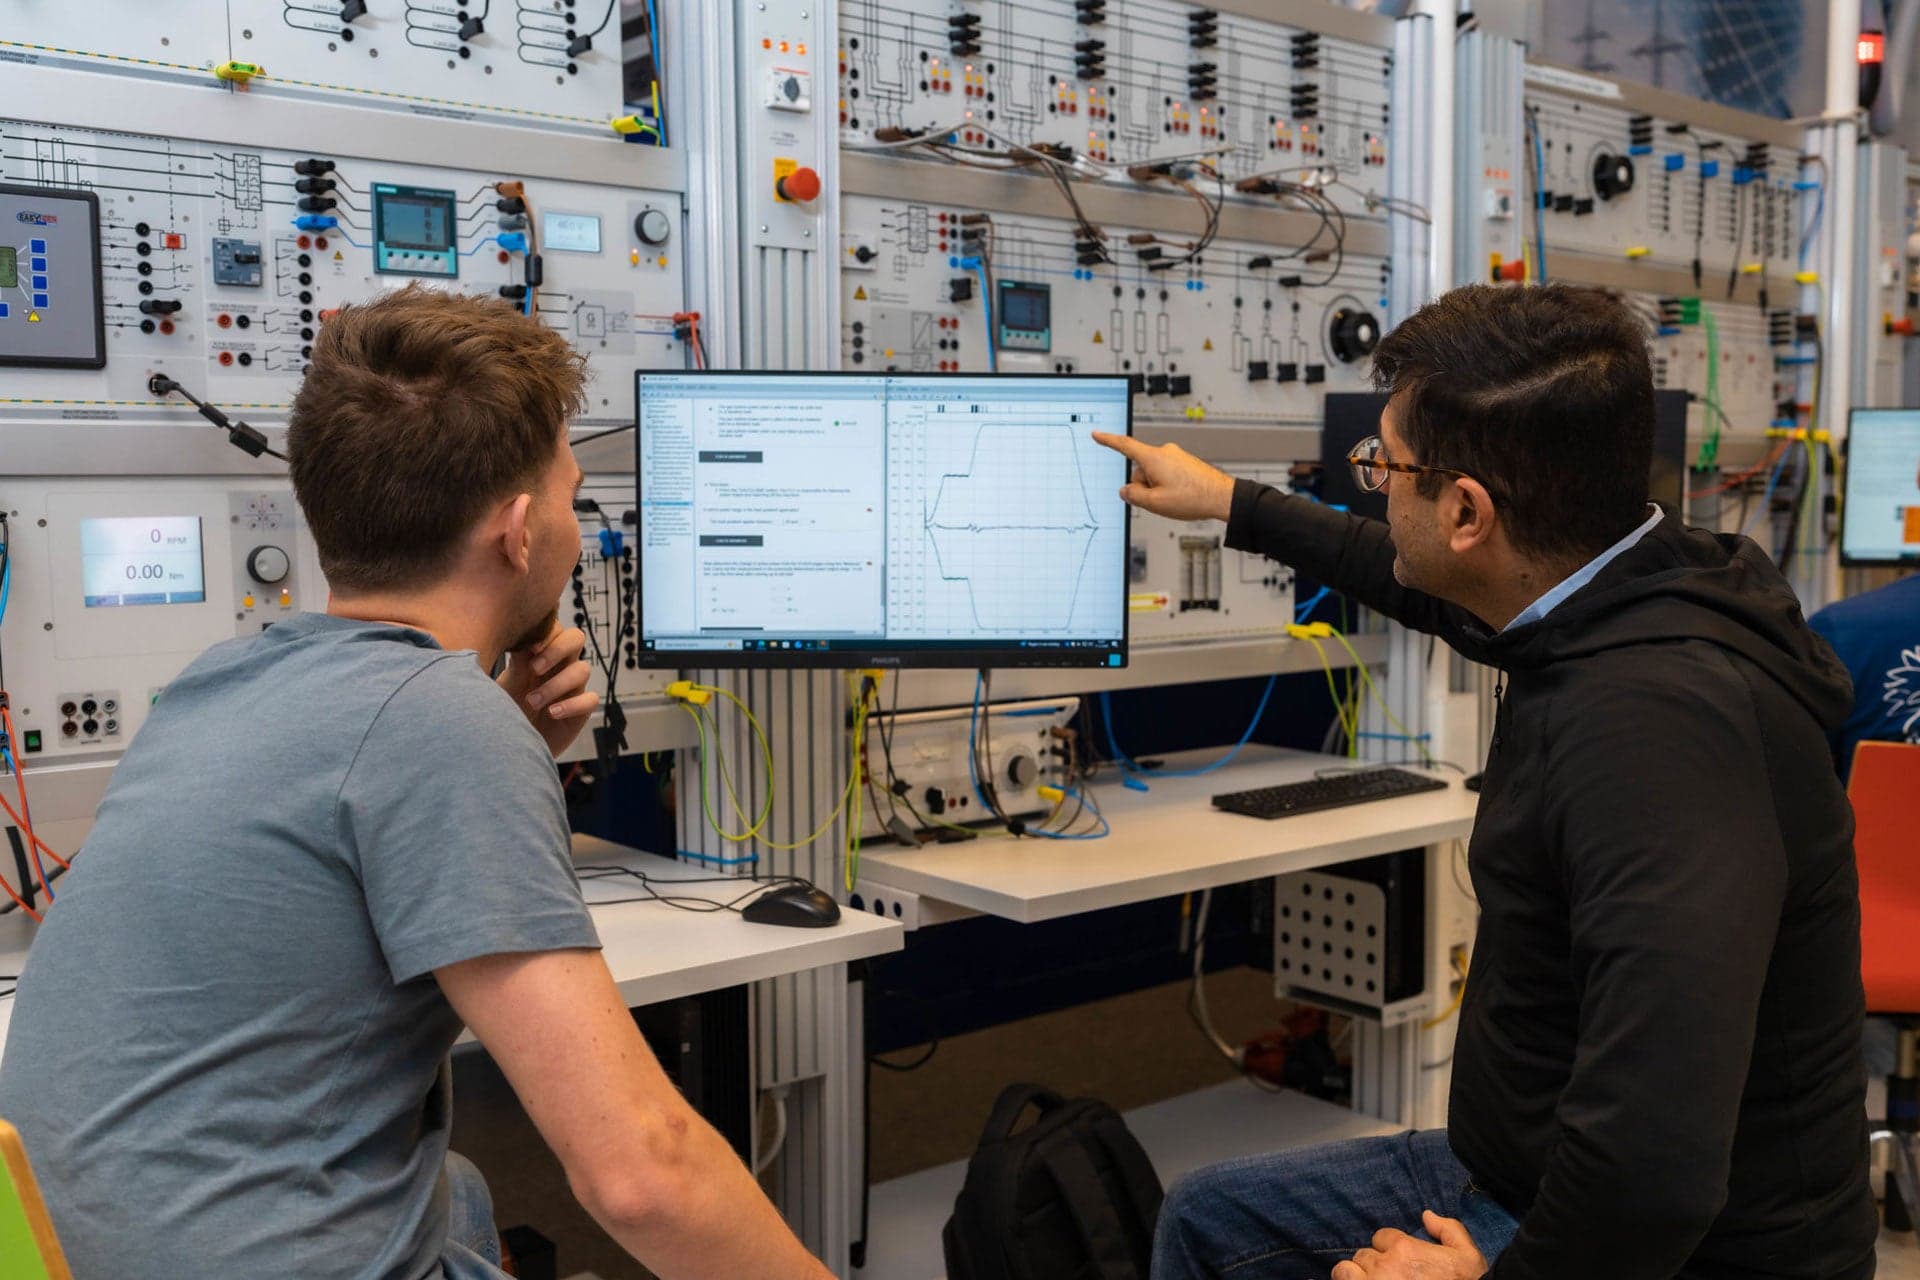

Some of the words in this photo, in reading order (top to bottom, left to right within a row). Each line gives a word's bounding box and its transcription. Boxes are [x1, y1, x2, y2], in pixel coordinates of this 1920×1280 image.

[150, 529, 161, 543] 0
[167, 537, 187, 545] RPM
[126, 564, 163, 580] 0.00
